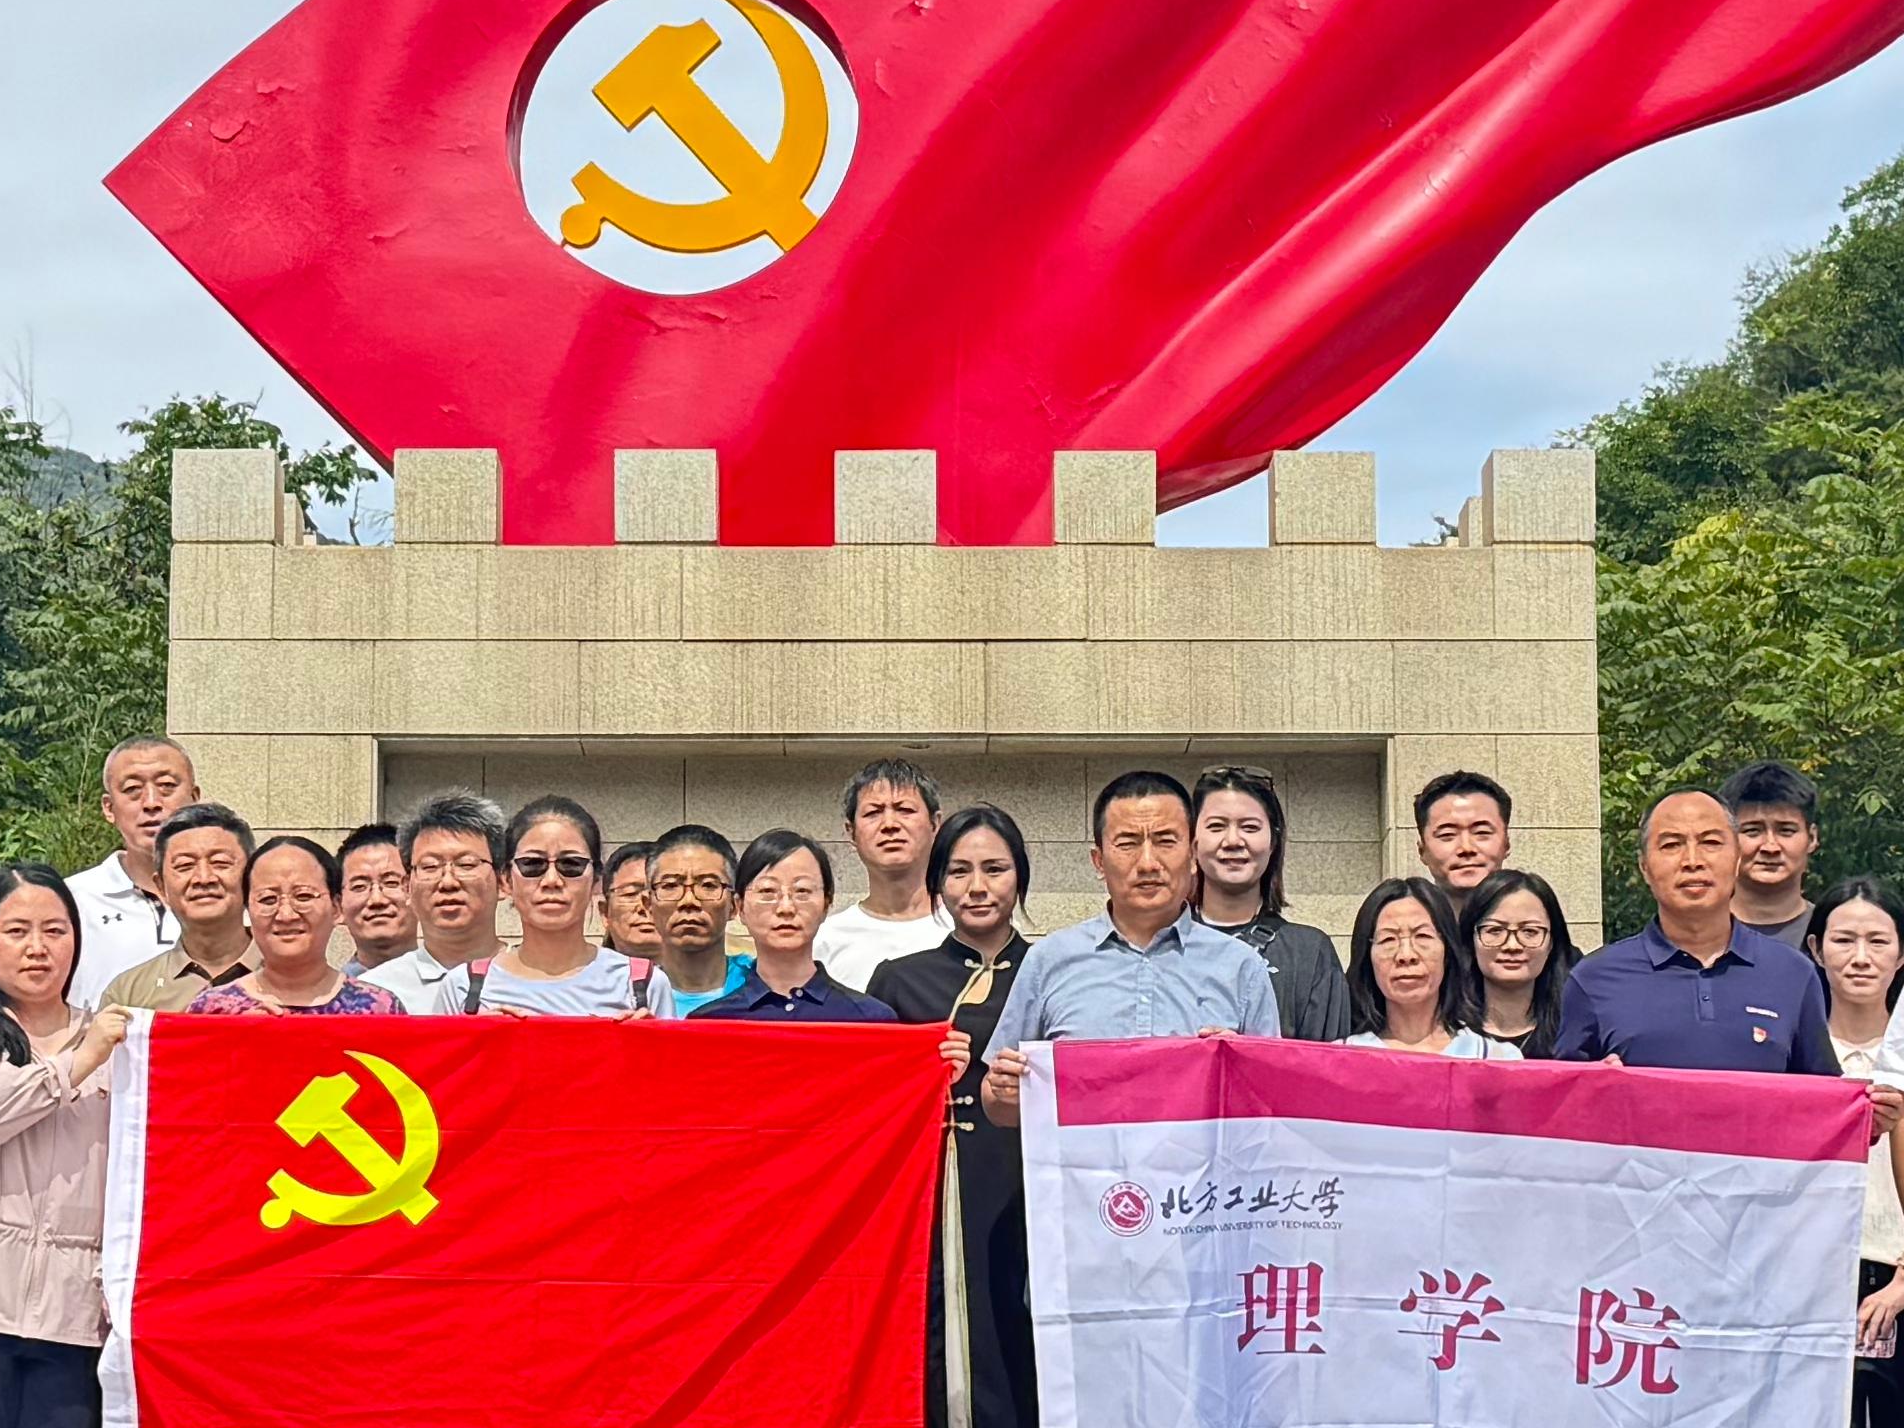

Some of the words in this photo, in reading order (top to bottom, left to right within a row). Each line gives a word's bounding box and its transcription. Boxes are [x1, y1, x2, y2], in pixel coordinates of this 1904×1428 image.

[1160, 1177, 1344, 1219] 北方工业大学
[1237, 1261, 1680, 1394] 理学院
